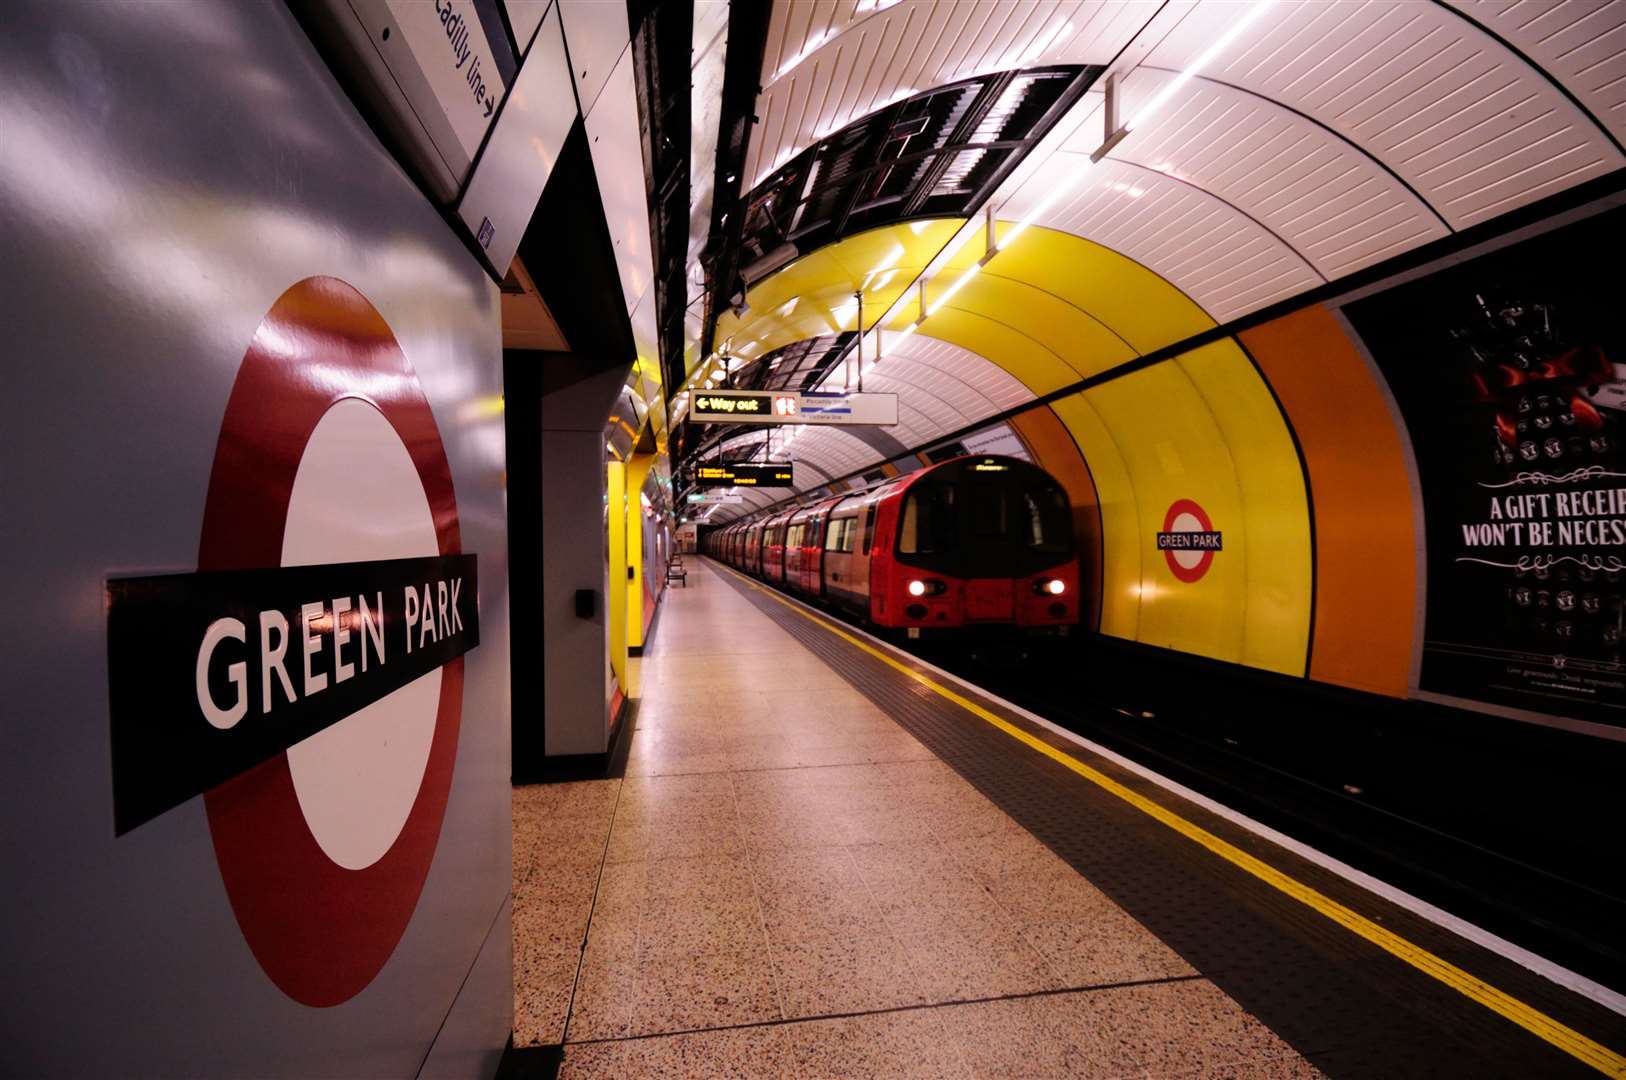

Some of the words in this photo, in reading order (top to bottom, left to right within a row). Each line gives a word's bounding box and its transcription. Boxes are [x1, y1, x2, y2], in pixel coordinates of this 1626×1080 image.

[467, 56, 485, 104] line
[709, 397, 735, 412] Way
[737, 399, 758, 411] out
[1489, 496, 1504, 520] A
[1505, 493, 1550, 519] GIFT
[1159, 534, 1190, 547] GREEN
[1193, 534, 1220, 547] PARK
[1461, 522, 1524, 547] WON'T
[1528, 521, 1553, 546] BE
[1558, 519, 1626, 546] NECES
[196, 592, 385, 729] GREEN
[405, 577, 464, 654] PARK
